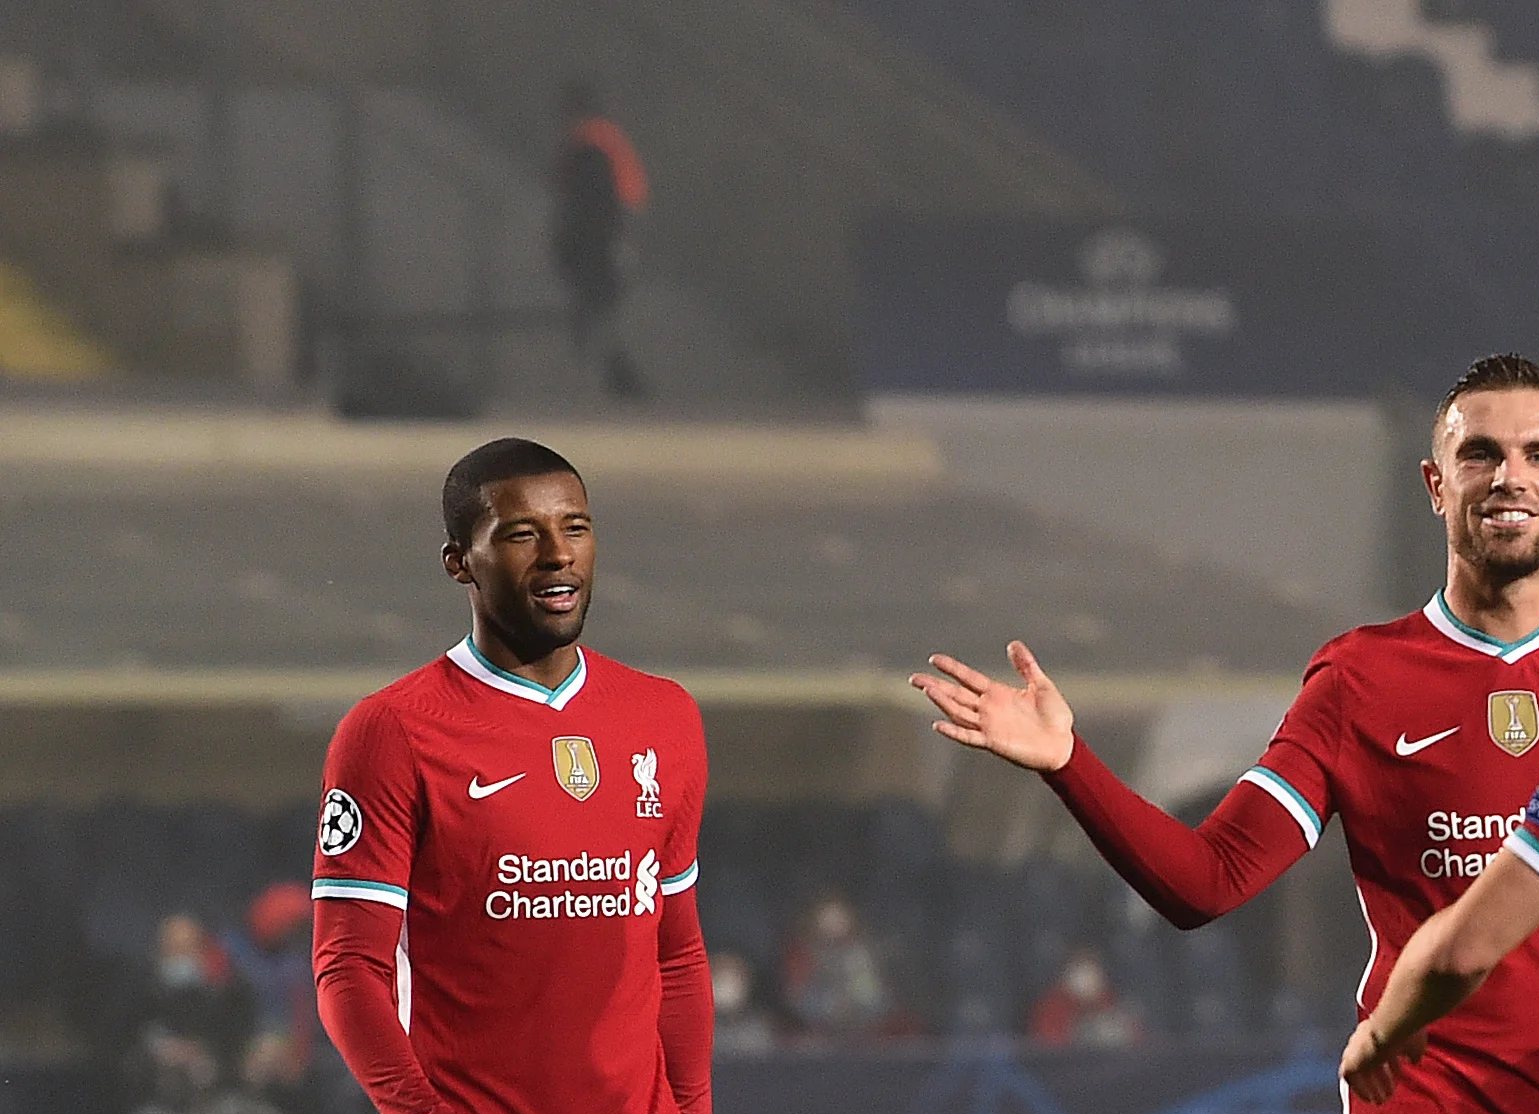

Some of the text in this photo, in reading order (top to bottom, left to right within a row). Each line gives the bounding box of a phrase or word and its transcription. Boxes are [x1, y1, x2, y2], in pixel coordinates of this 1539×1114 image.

[1505, 731, 1527, 739] FIFA
[1427, 807, 1527, 841] Stand
[498, 850, 631, 884] Standard
[486, 888, 630, 918] Chartered
